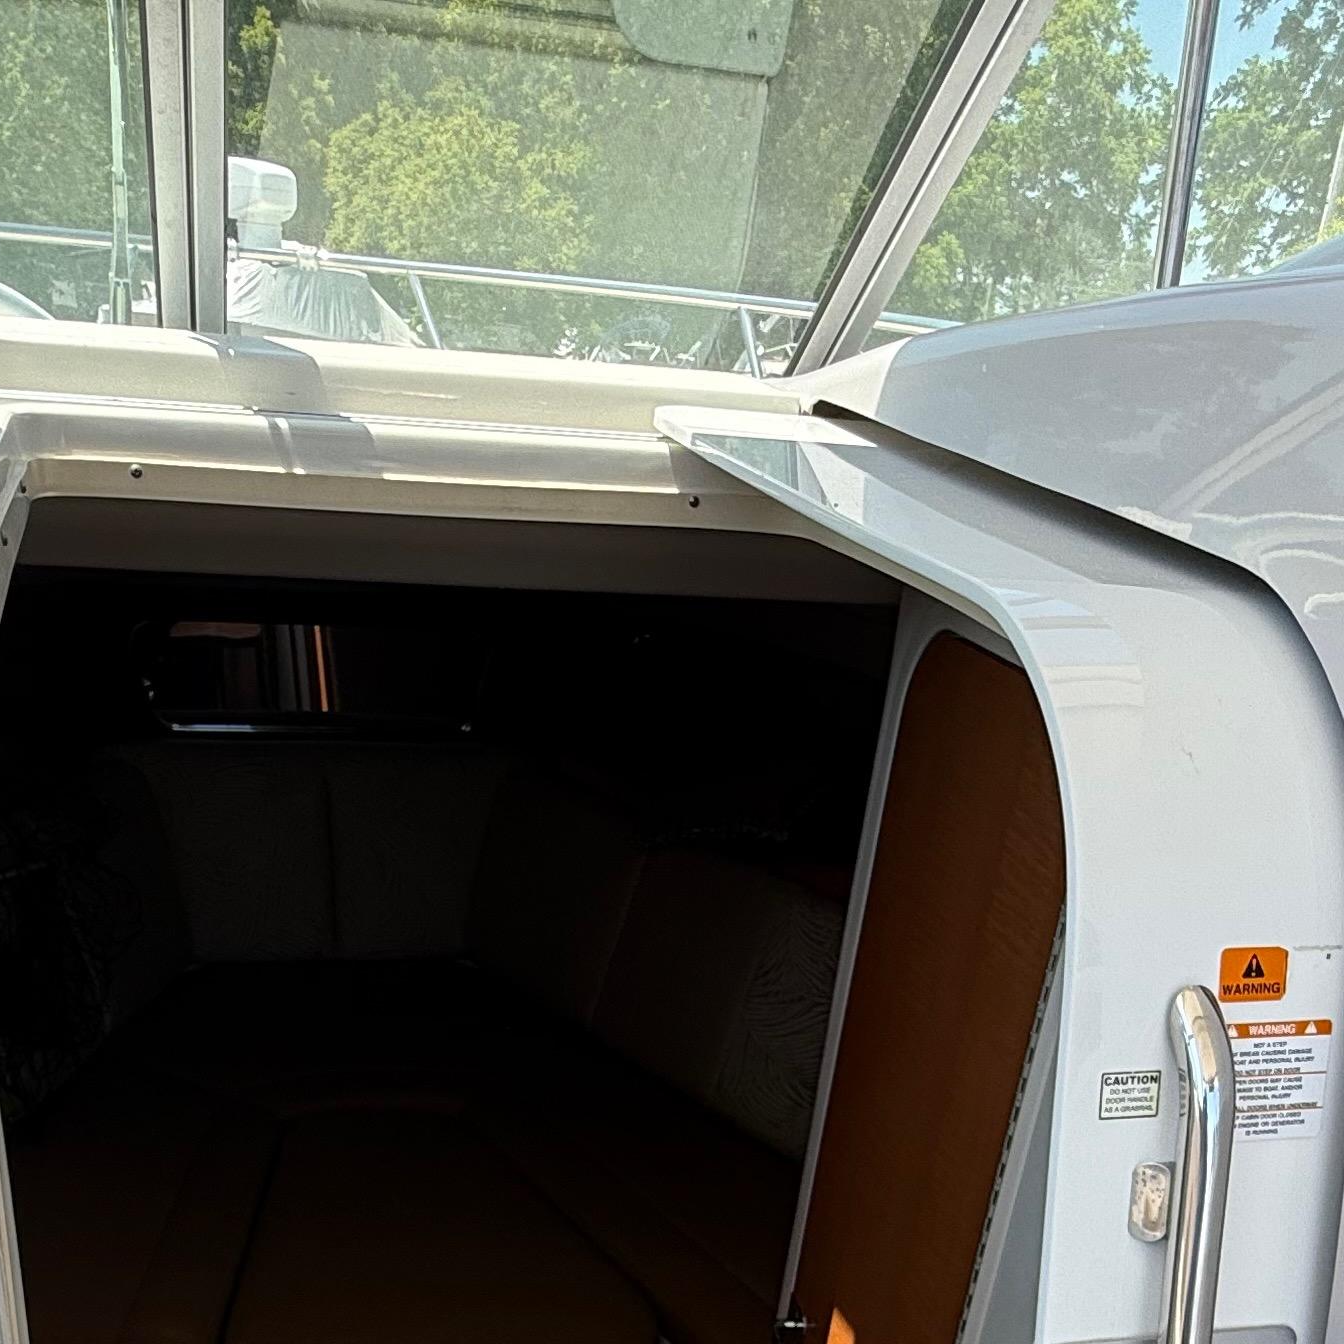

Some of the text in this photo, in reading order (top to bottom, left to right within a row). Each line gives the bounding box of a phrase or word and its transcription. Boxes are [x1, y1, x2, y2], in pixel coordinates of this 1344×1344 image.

[1222, 982, 1281, 996] WARNING
[1248, 1023, 1296, 1036] WARNING
[1104, 1074, 1159, 1087] CAUTION
